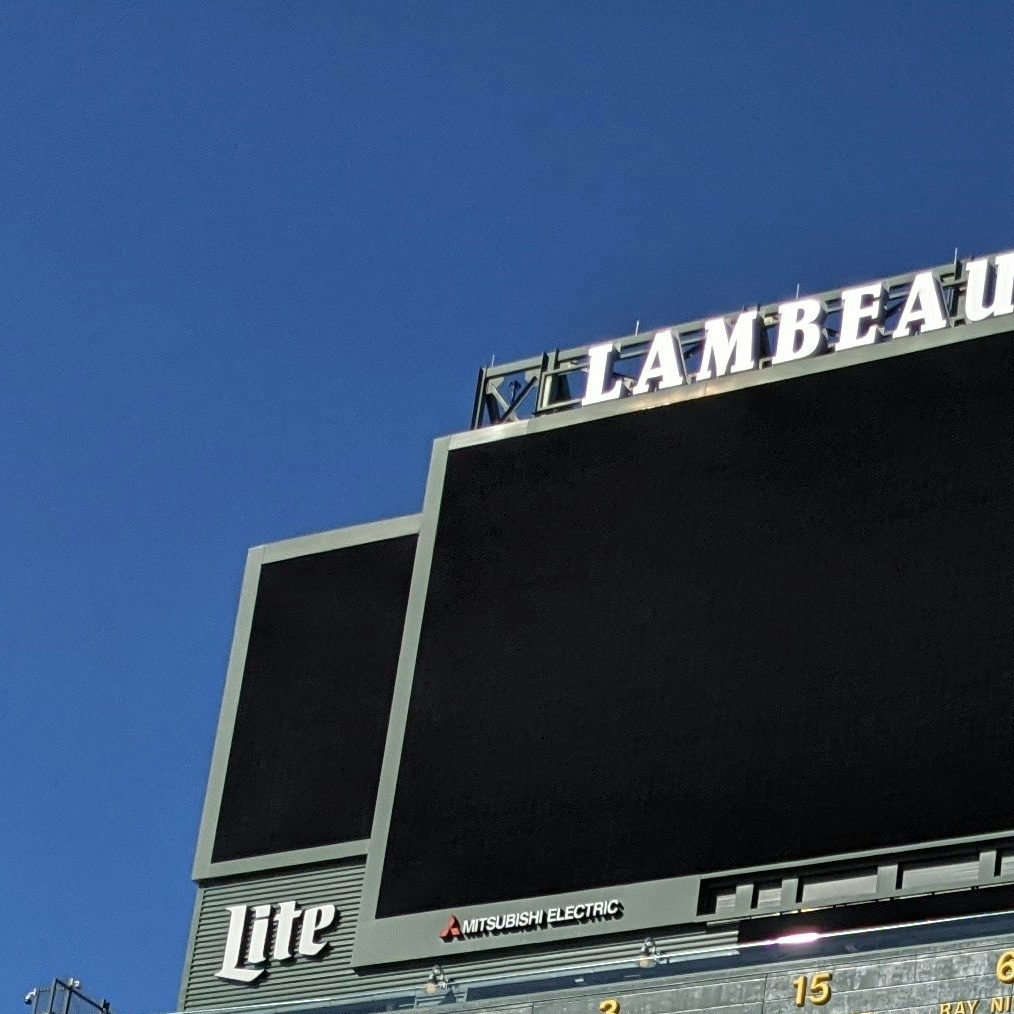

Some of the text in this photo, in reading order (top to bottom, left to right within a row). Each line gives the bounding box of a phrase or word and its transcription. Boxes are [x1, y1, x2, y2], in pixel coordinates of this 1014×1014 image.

[462, 899, 619, 935] MITSUBISHI ELECTRIC
[214, 901, 337, 983] Lite
[792, 972, 833, 1007] 15
